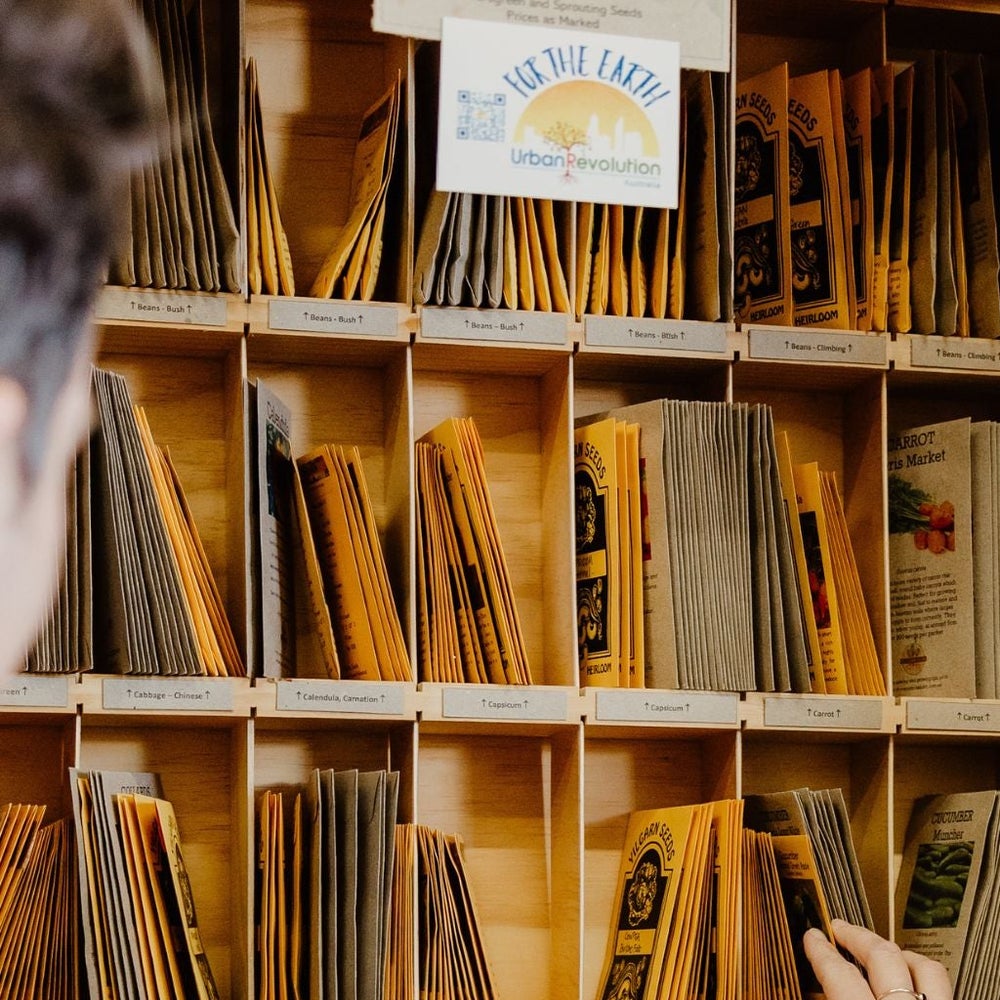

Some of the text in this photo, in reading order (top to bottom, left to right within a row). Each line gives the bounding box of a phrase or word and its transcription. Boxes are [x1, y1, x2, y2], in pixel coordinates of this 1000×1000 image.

[553, 0, 608, 17] Sprouting
[611, 6, 643, 19] Seeds
[507, 10, 600, 29] Prices as Marked
[503, 45, 671, 108] FOR THE EARTH
[750, 92, 777, 126] SEEDS
[788, 99, 818, 132] EEDS
[137, 303, 185, 313] Beans Bush
[750, 305, 784, 321] HEIRLOOM
[310, 314, 357, 323] Beans Bush
[794, 310, 838, 326] HEIRLOOM
[471, 322, 517, 331] Beans Bush
[634, 331, 655, 340] Beans
[791, 344, 846, 354] Beans Climbing
[942, 352, 996, 362] Beans Climbing
[585, 442, 607, 479] SEEDS
[888, 449, 946, 472] ris Market
[587, 663, 613, 676] HEIRLOOM
[133, 690, 203, 700] Cabbage Chinese
[303, 693, 342, 704] Calendula,
[488, 700, 522, 709] Capsicum
[650, 702, 684, 712] Capsicum
[813, 710, 835, 718] Carrot
[963, 713, 984, 721] Carrot
[931, 810, 975, 825] CUCUMBER
[660, 823, 676, 862] SEEDS
